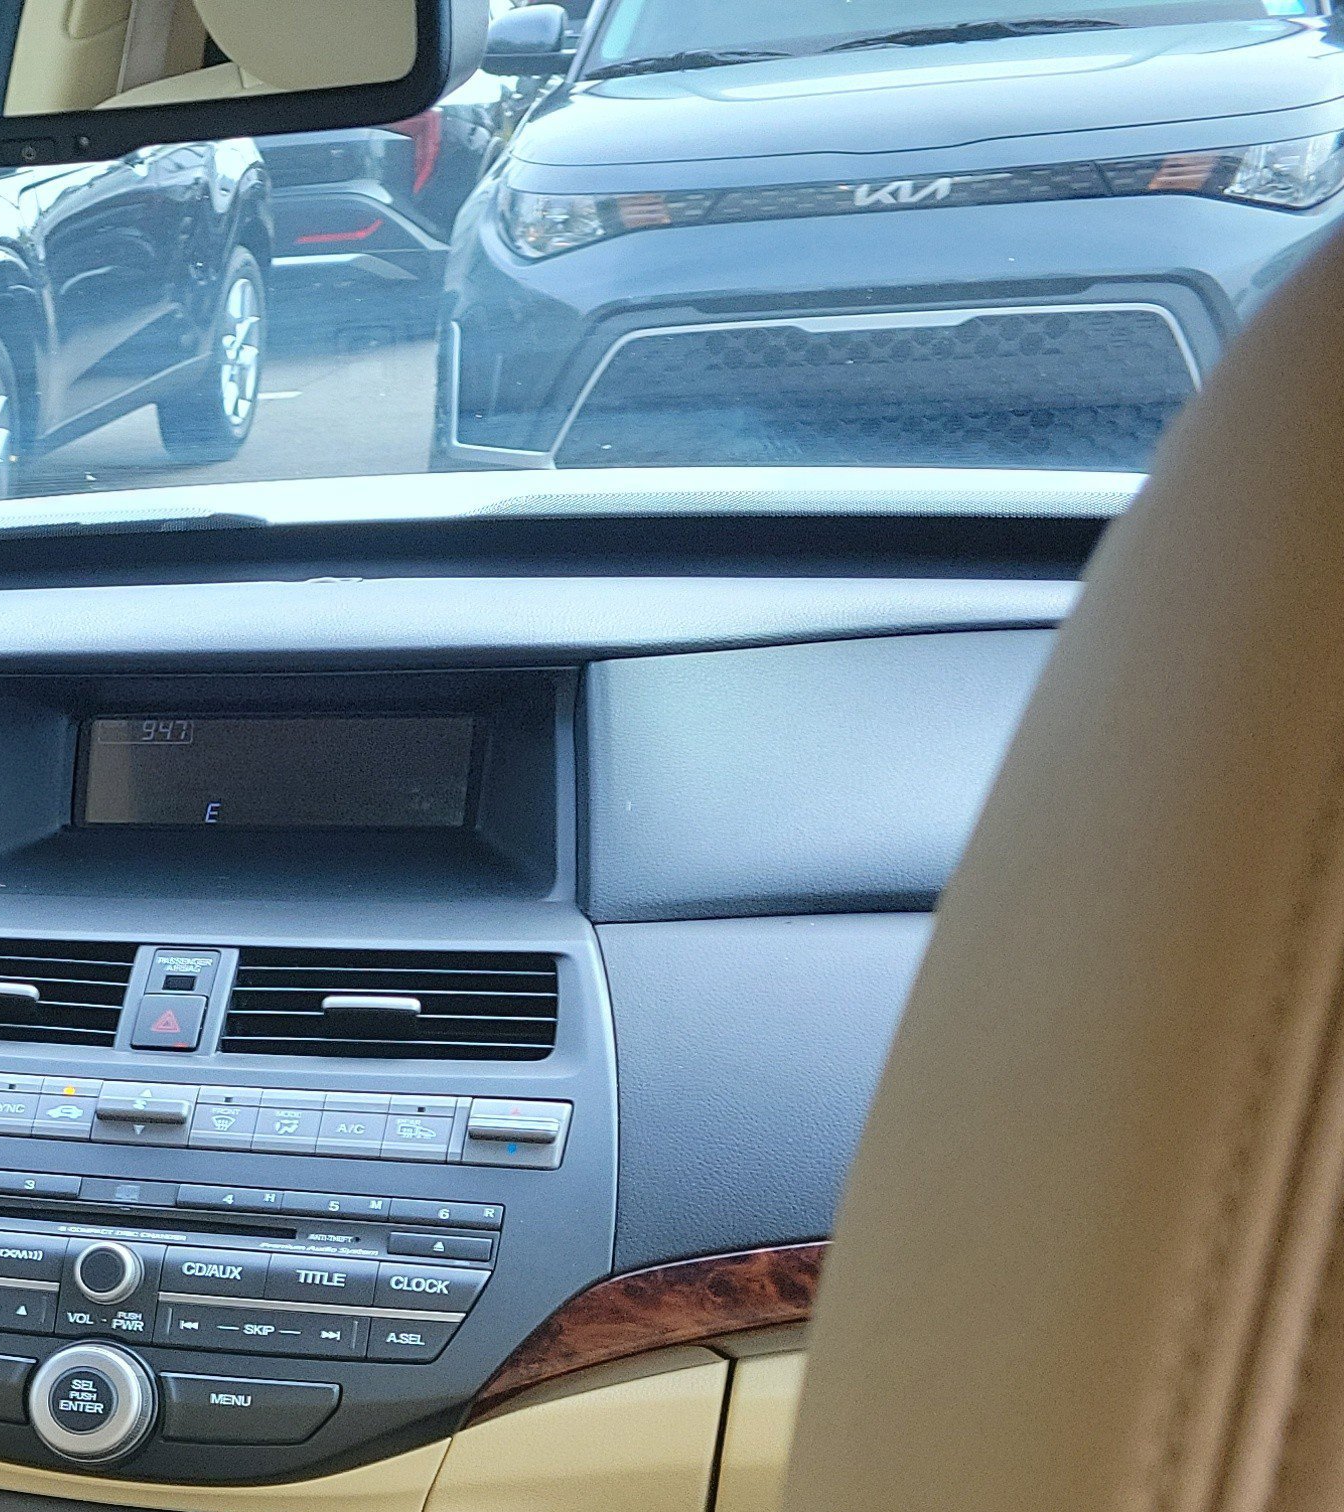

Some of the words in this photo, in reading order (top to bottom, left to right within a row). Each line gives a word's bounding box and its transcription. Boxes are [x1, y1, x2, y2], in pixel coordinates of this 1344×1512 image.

[212, 1107, 241, 1115] FRONT
[336, 1123, 365, 1134] A/C
[24, 1180, 36, 1190] 3
[223, 1194, 234, 1204] 4
[264, 1193, 276, 1202] H
[328, 1201, 340, 1211] 5
[369, 1200, 382, 1210] M
[438, 1208, 450, 1219] 6
[484, 1208, 495, 1218] R
[67, 1226, 114, 1235] COMPACT
[115, 1229, 139, 1237] DISC
[182, 1262, 243, 1280] CD/AUX
[295, 1269, 347, 1288] TITLE
[389, 1275, 450, 1295] CLOCK
[67, 1312, 94, 1325] VOL
[116, 1311, 142, 1320] PUSH
[112, 1319, 145, 1332] PWR
[243, 1324, 275, 1336] SKIP
[70, 1379, 98, 1392] SEL
[69, 1391, 97, 1401] PUSH
[209, 1393, 252, 1408] MENU
[59, 1400, 105, 1414] ENTER
